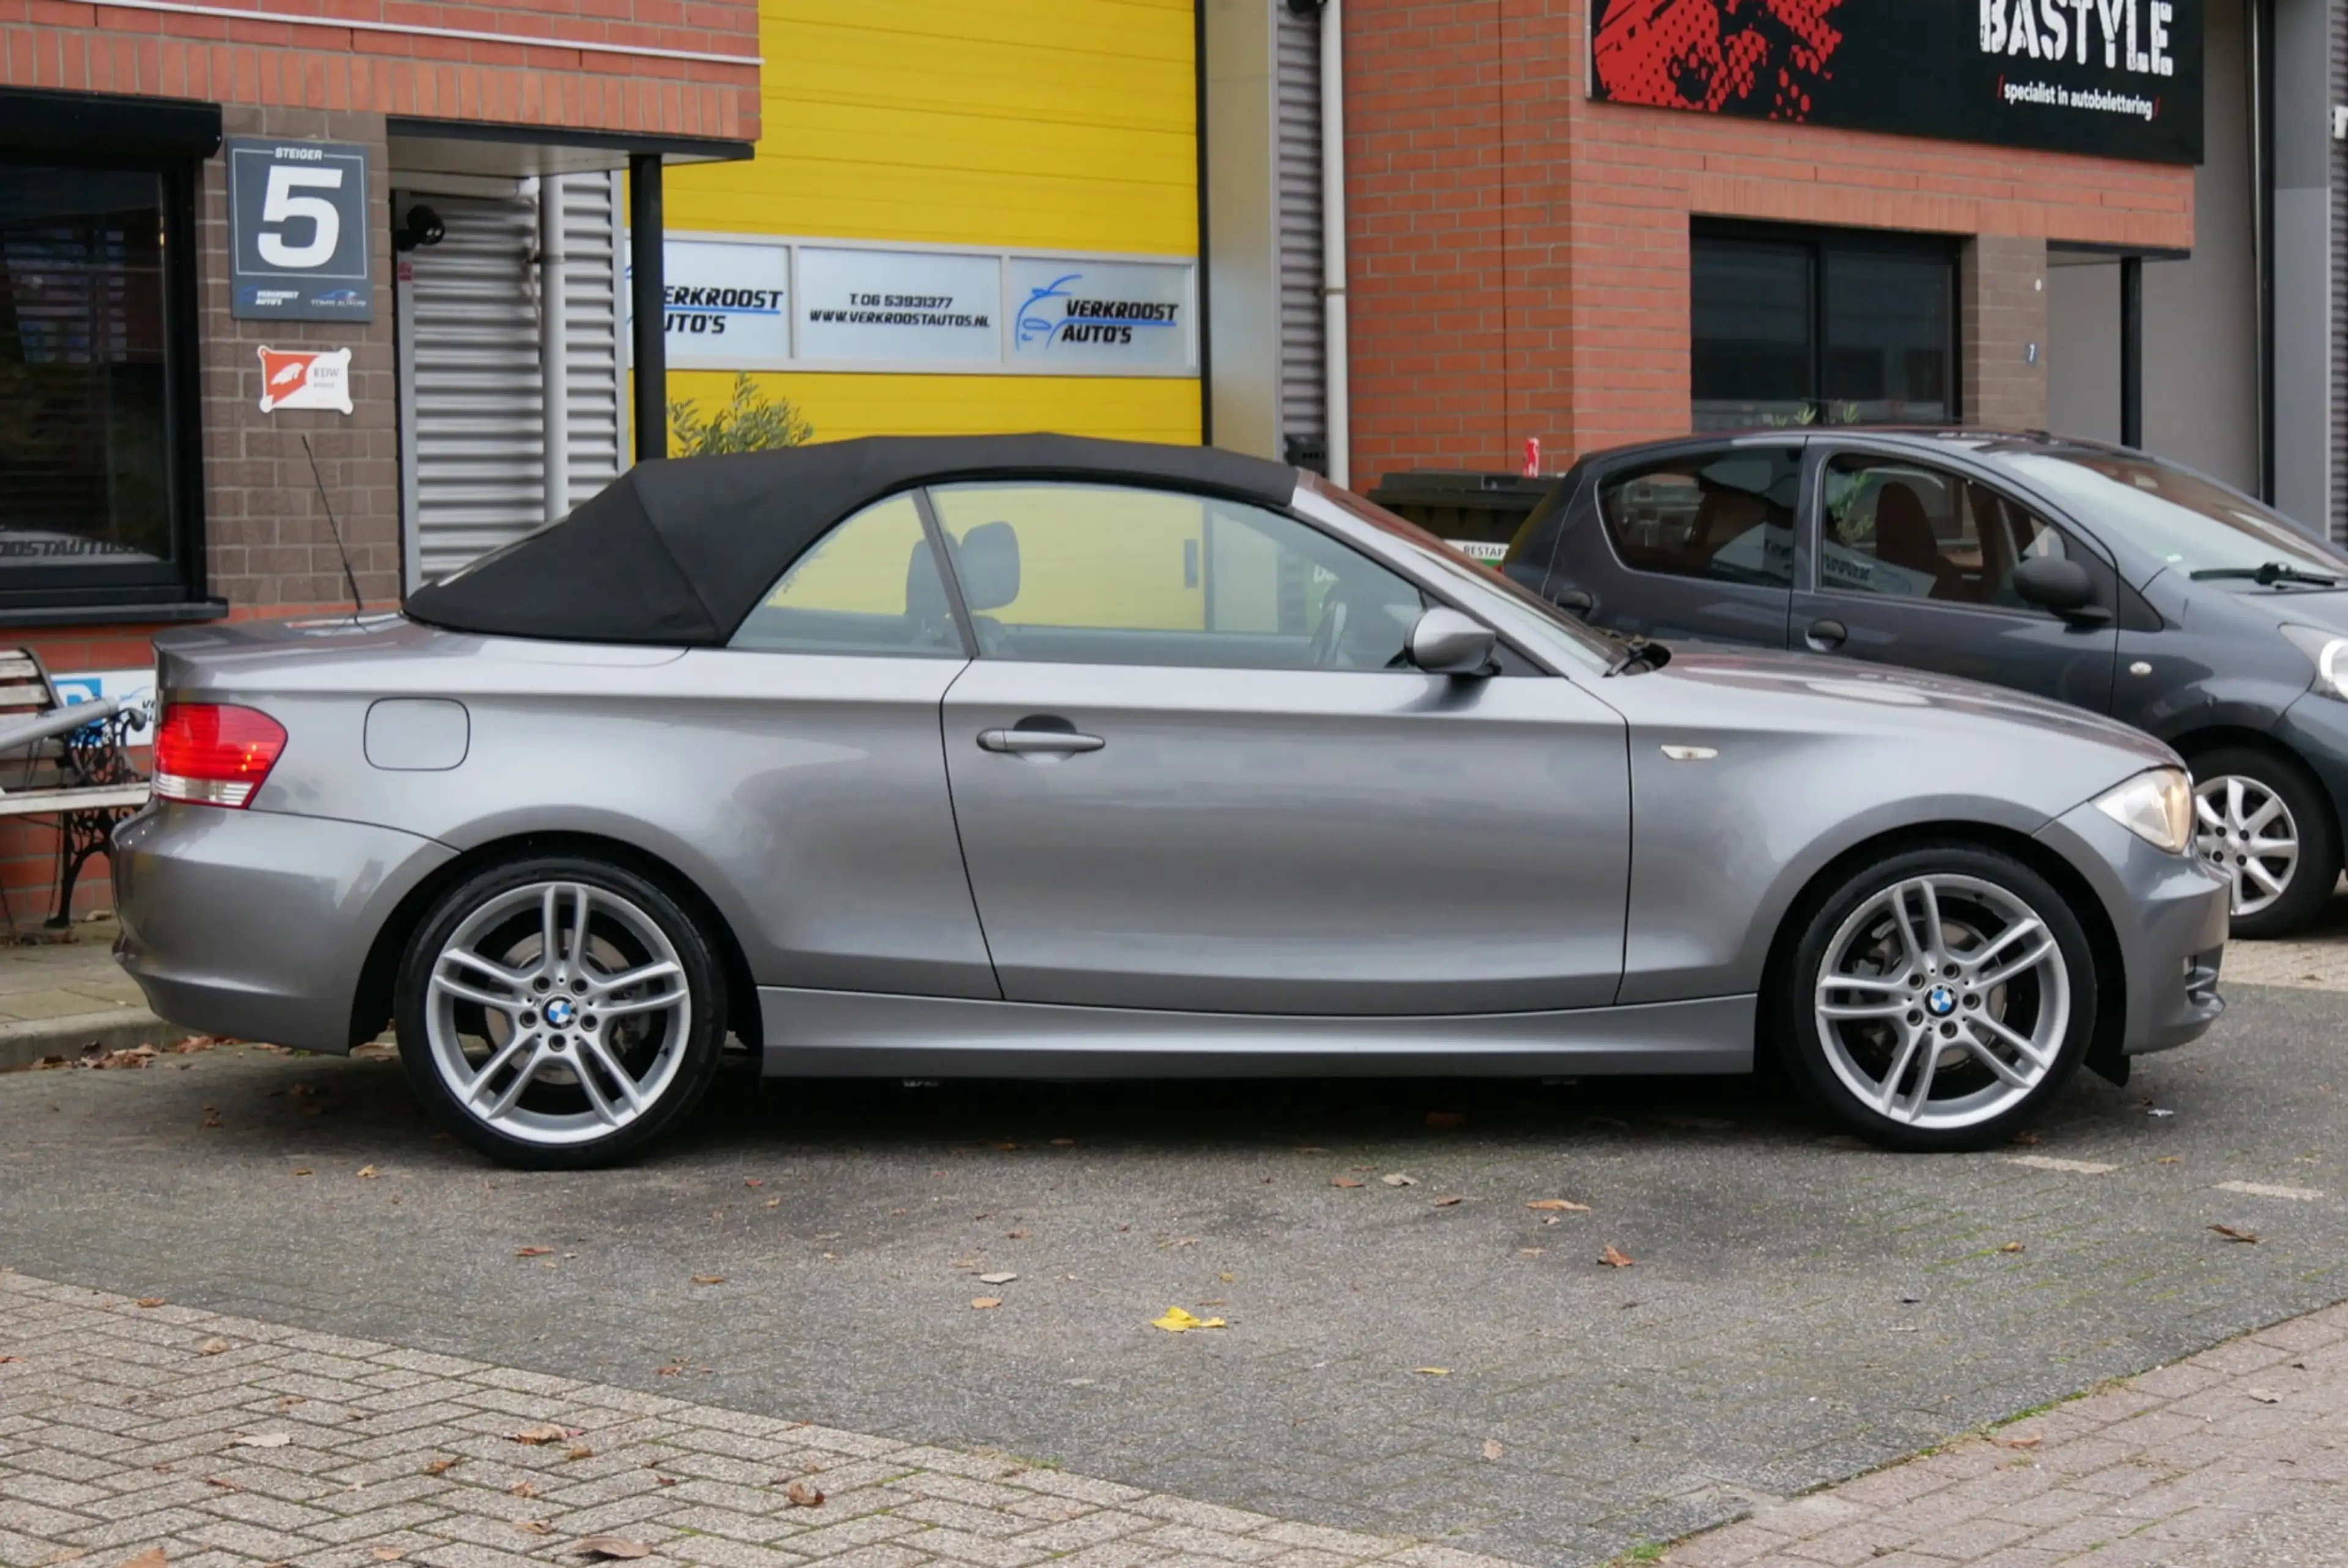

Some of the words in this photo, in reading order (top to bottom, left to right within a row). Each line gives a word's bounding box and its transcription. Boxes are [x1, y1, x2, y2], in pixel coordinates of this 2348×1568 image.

[1979, 0, 2174, 76] BASTYLE
[2058, 84, 2069, 105] in
[275, 147, 323, 161] STEIGER
[258, 165, 343, 268] 5
[664, 285, 784, 309] ERKROOST
[860, 294, 881, 306] 06
[810, 308, 991, 328] WWW.VERKROOSTAUTOS.NL
[1066, 299, 1180, 321] VERKROOST
[1061, 325, 1132, 344] AUTO'S
